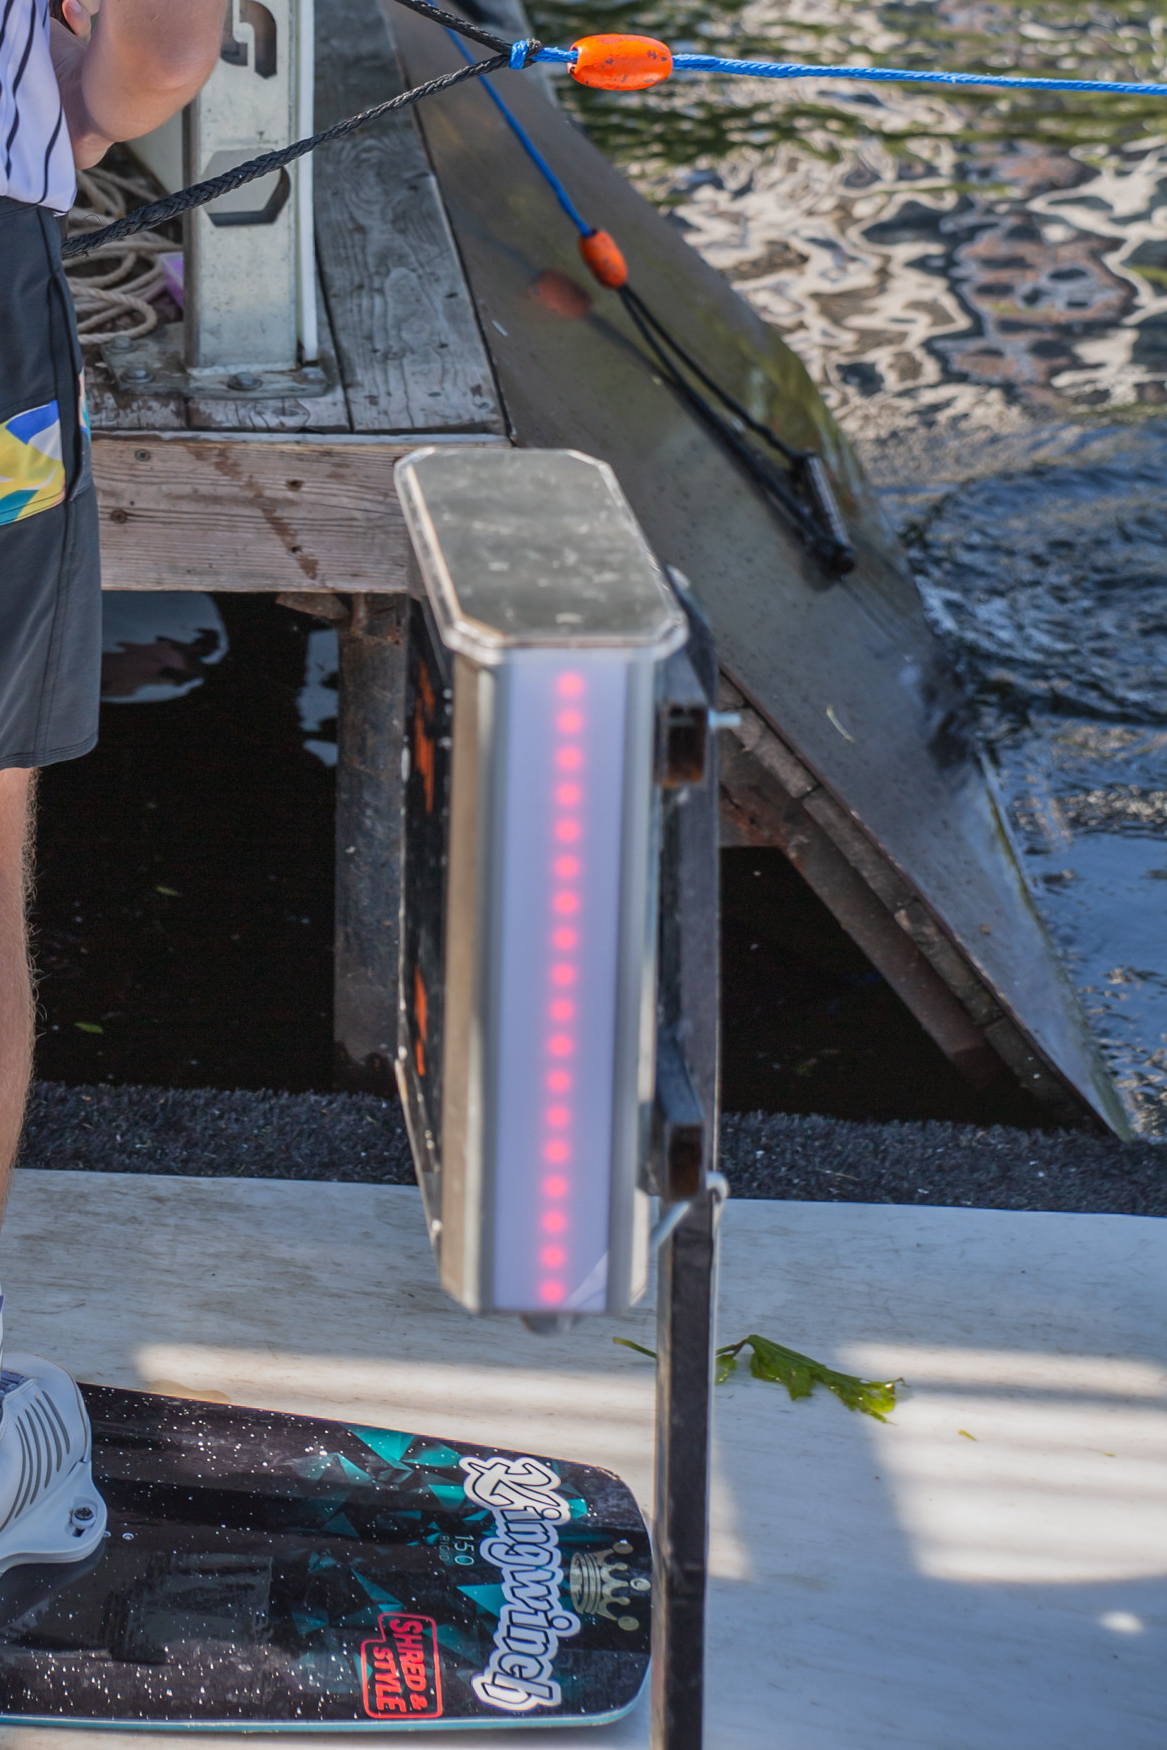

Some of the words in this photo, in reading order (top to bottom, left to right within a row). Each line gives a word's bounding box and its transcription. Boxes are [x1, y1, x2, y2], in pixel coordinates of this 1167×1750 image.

[454, 1534, 475, 1566] 150
[461, 1457, 578, 1709] Kingwinch
[372, 1646, 406, 1713] STYLE
[389, 1618, 427, 1691] SHRED
[410, 1694, 428, 1710] &
